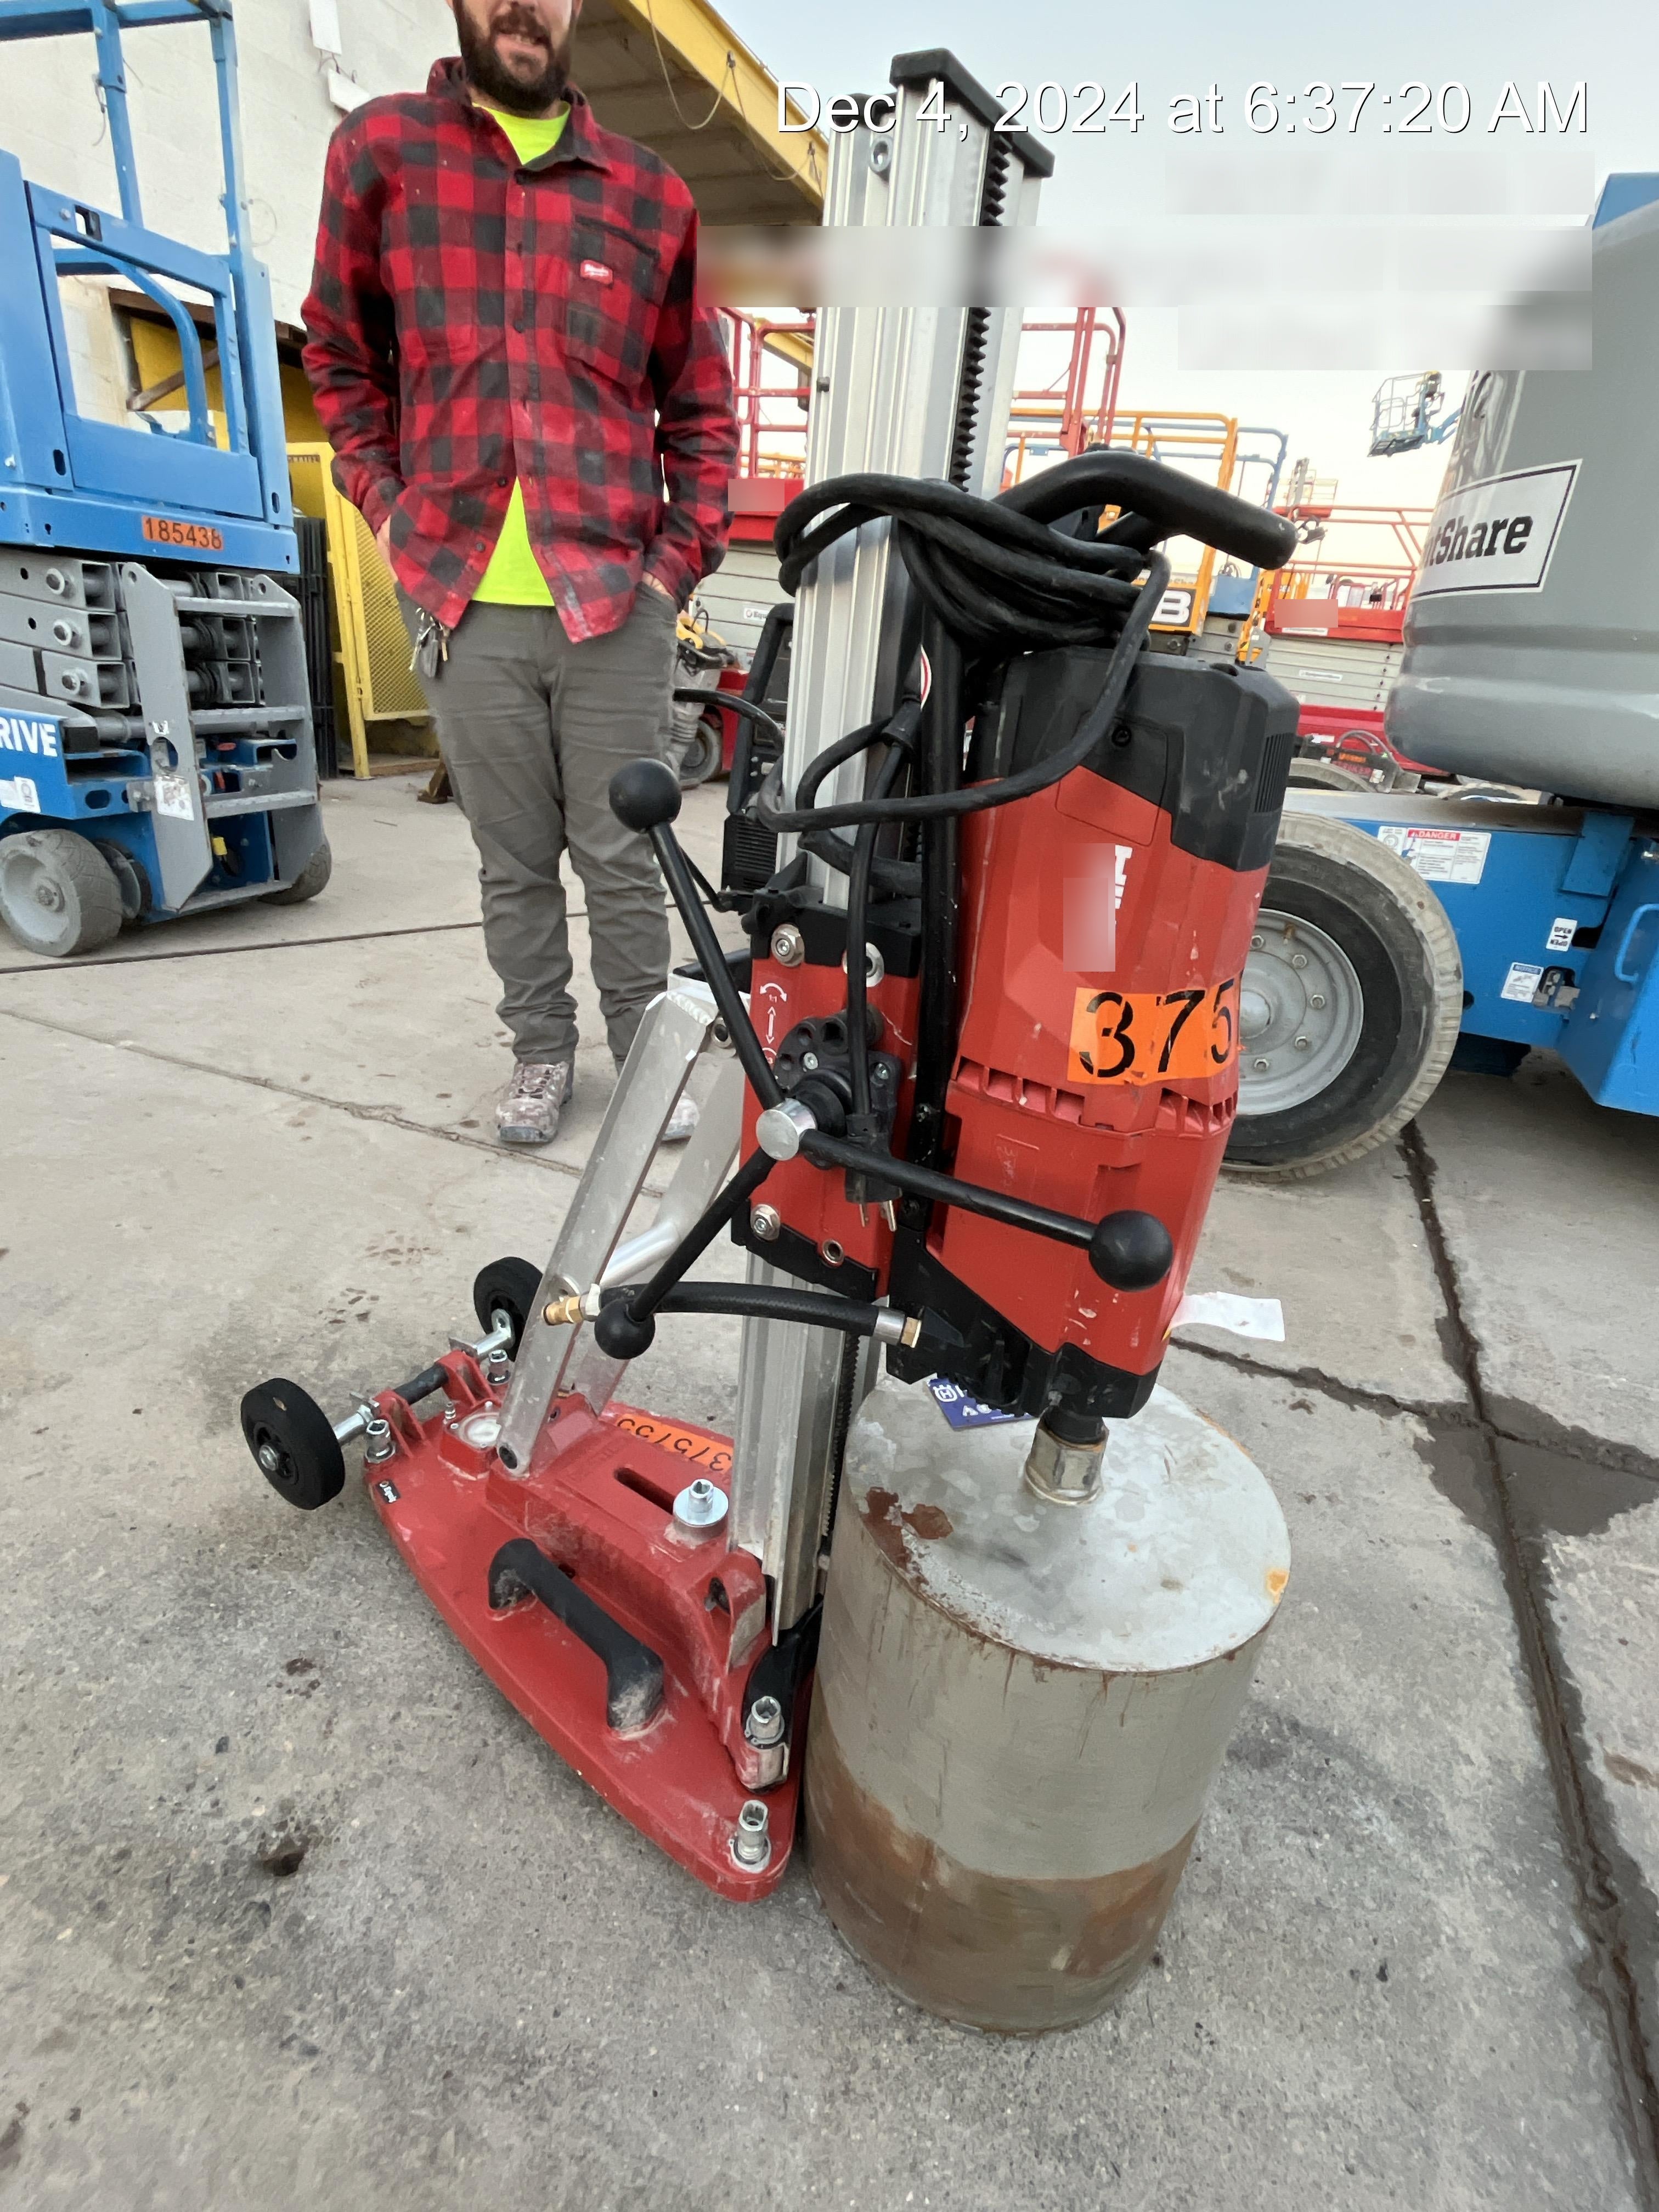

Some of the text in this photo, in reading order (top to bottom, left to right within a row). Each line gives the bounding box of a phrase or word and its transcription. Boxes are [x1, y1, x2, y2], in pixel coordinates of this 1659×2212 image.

[145, 517, 222, 550] 185438
[1418, 831, 1457, 840] DANGER
[1079, 978, 1234, 1078] 375
